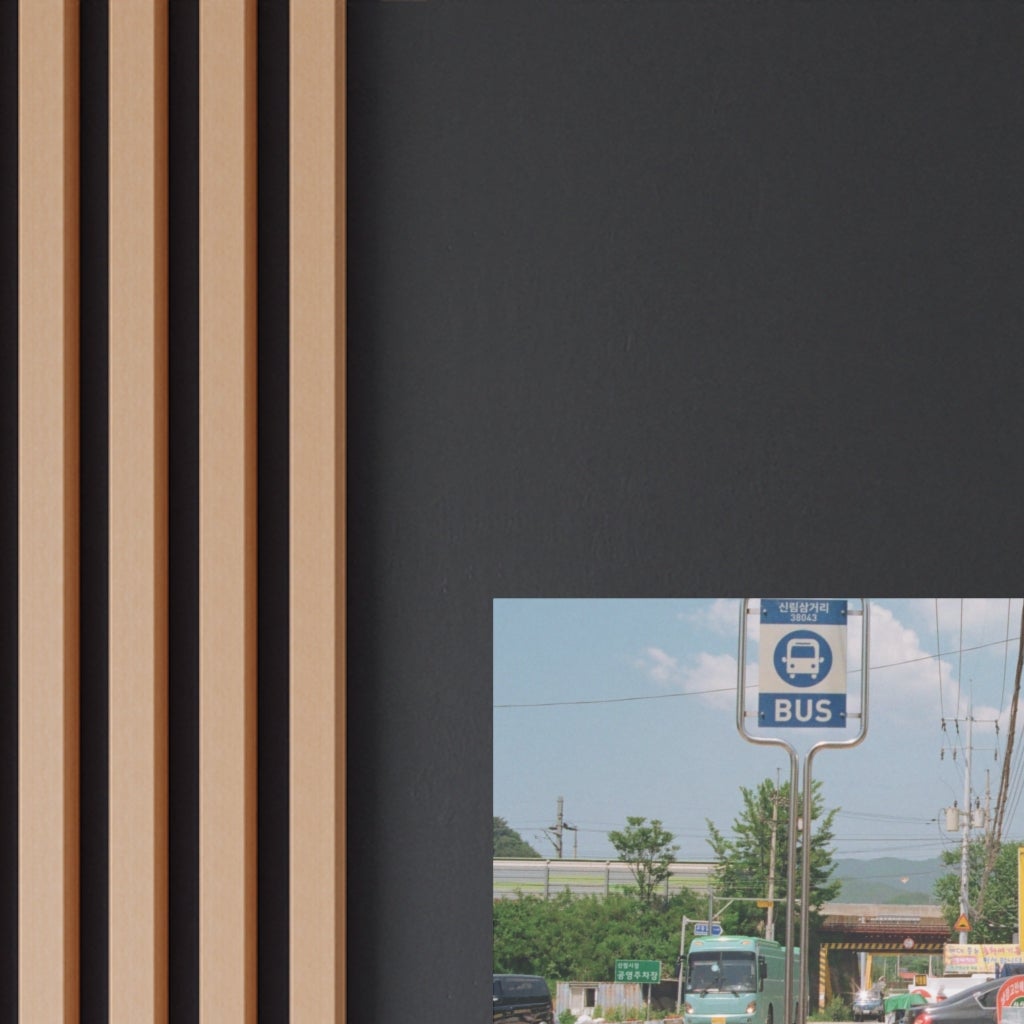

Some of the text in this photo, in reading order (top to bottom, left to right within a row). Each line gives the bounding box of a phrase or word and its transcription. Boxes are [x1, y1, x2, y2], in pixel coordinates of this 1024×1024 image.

[778, 602, 829, 614] 신림삼거리
[790, 614, 818, 622] 38043
[774, 698, 832, 722] BUS
[617, 970, 658, 981] 공영주차장
